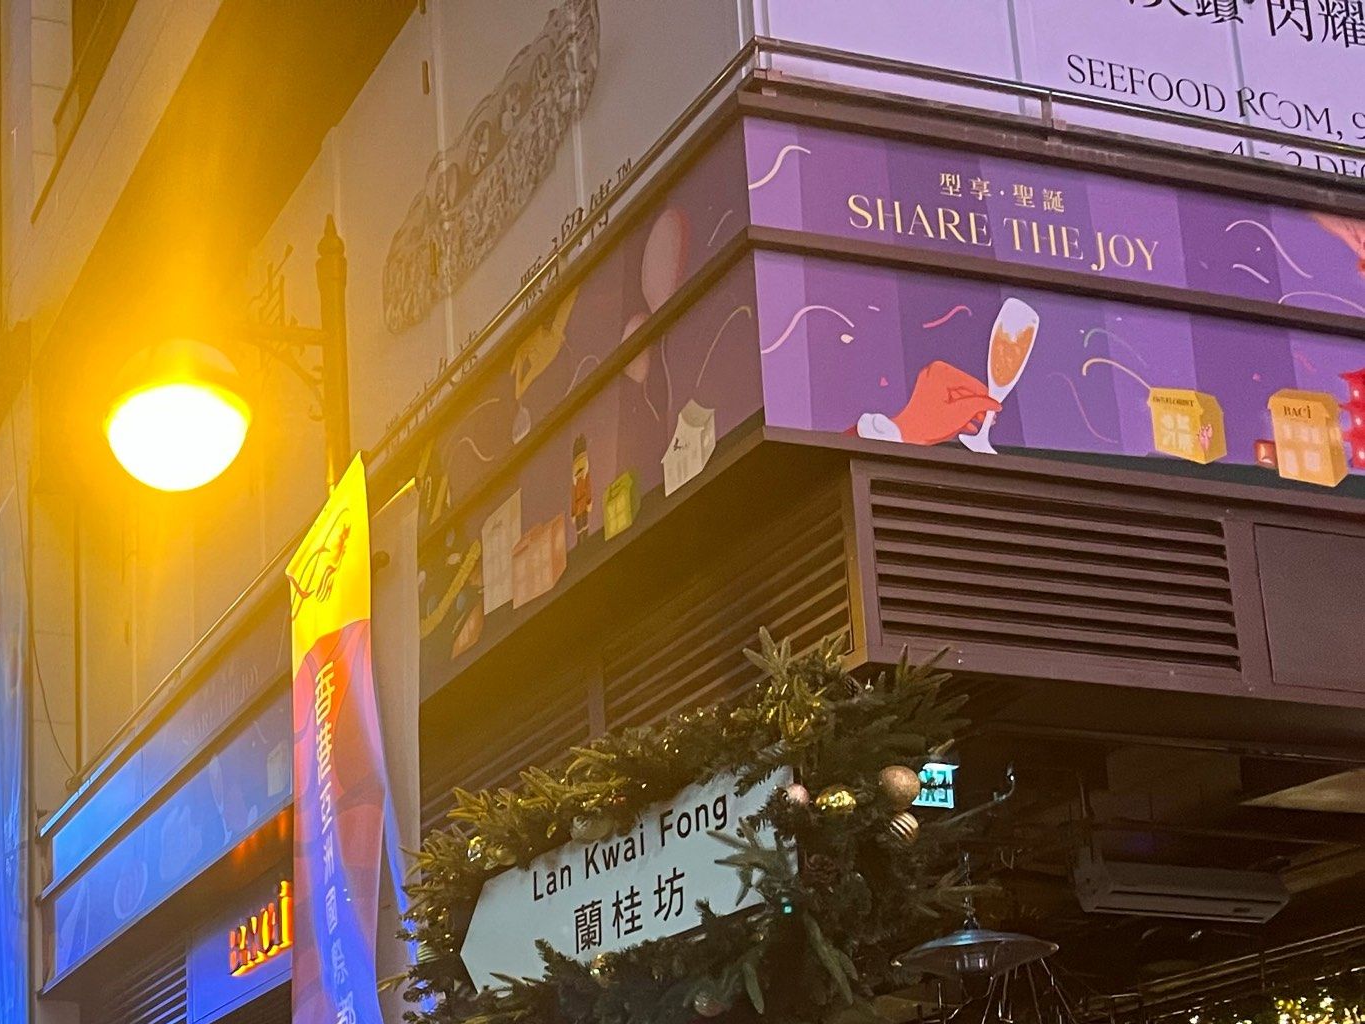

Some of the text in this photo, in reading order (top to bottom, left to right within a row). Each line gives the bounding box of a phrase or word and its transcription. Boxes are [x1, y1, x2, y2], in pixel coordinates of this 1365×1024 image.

[1067, 54, 1227, 113] SEEFOOD
[847, 194, 1159, 272] SHARE THE JOY
[533, 794, 728, 901] Lan Kwai Fong
[573, 867, 685, 954] 蘭桂坊
